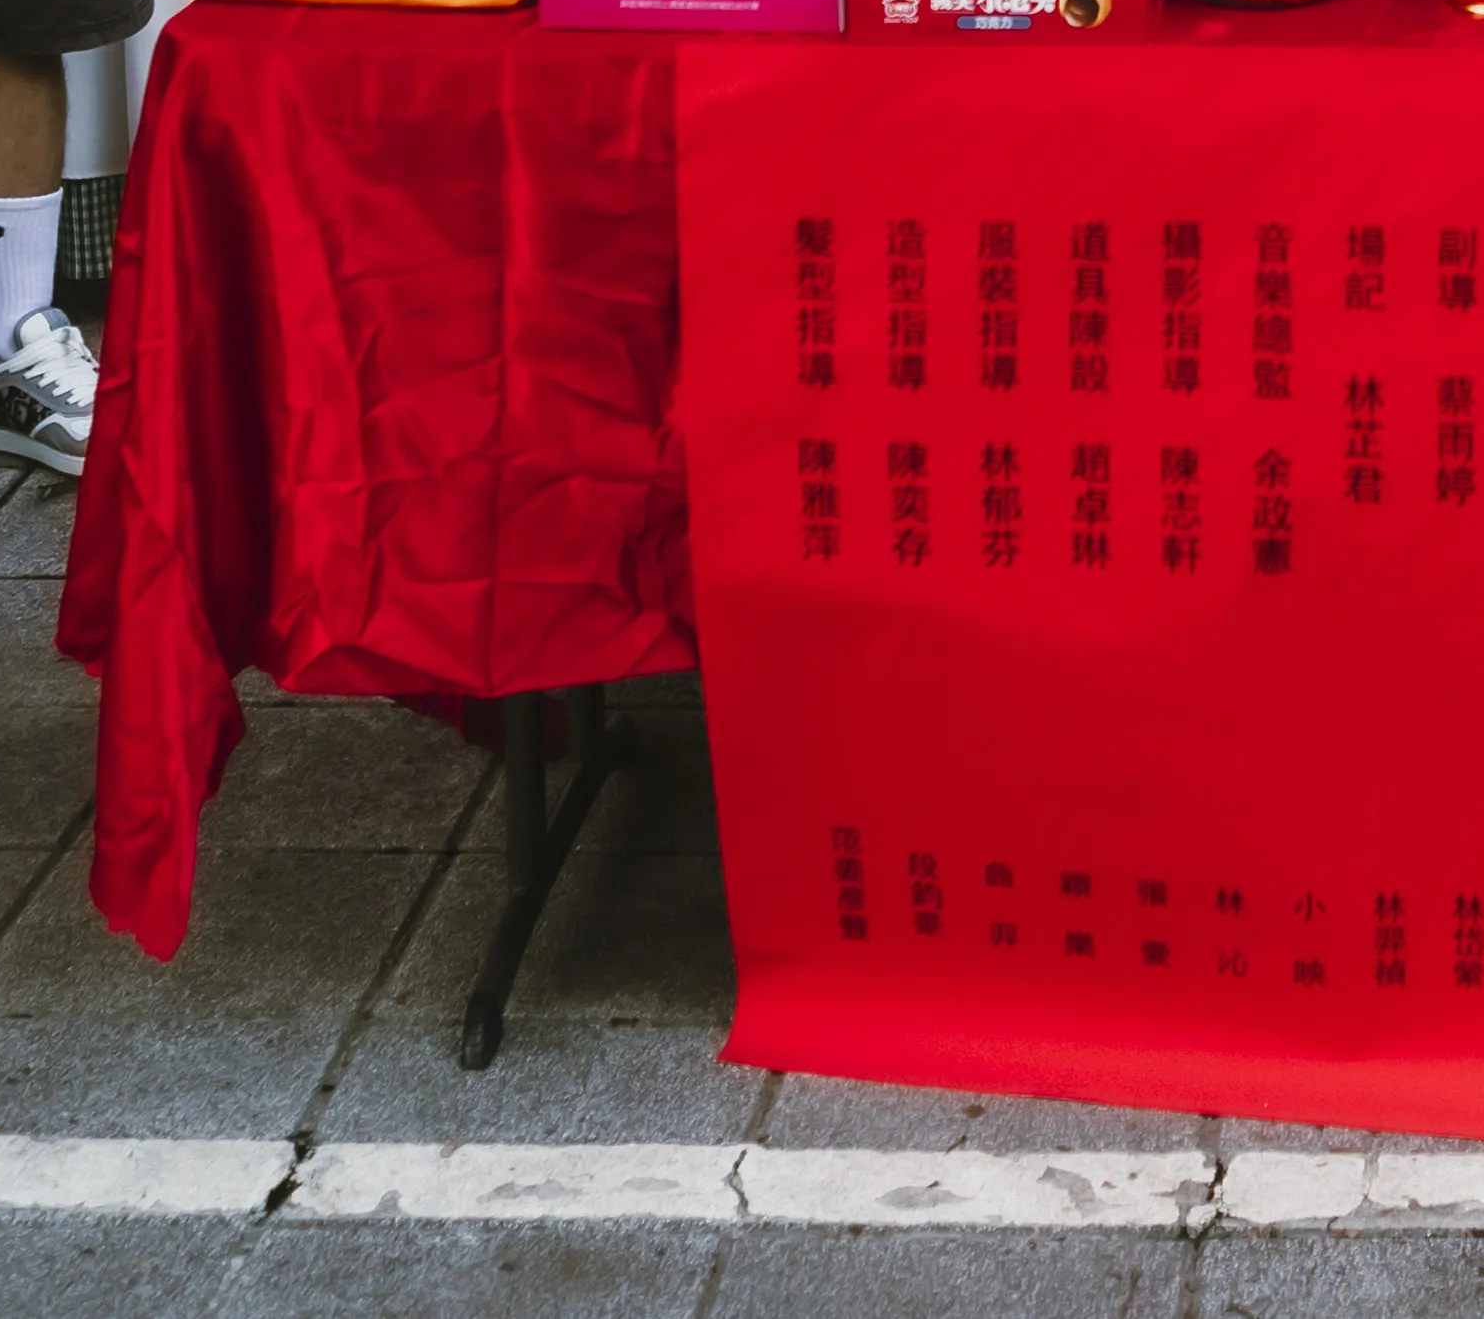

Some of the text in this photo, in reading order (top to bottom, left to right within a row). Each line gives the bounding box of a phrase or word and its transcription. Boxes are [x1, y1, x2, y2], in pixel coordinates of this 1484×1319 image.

[794, 217, 837, 391] 髮型指導
[887, 218, 927, 392] 造型指導
[978, 221, 1019, 392] 服裝指導
[1069, 221, 1110, 393] 道具陳設
[1162, 221, 1202, 396] 攝影指導
[1252, 222, 1293, 400] 音樂總監
[1345, 225, 1387, 311] 場記
[1438, 229, 1477, 313] 副導
